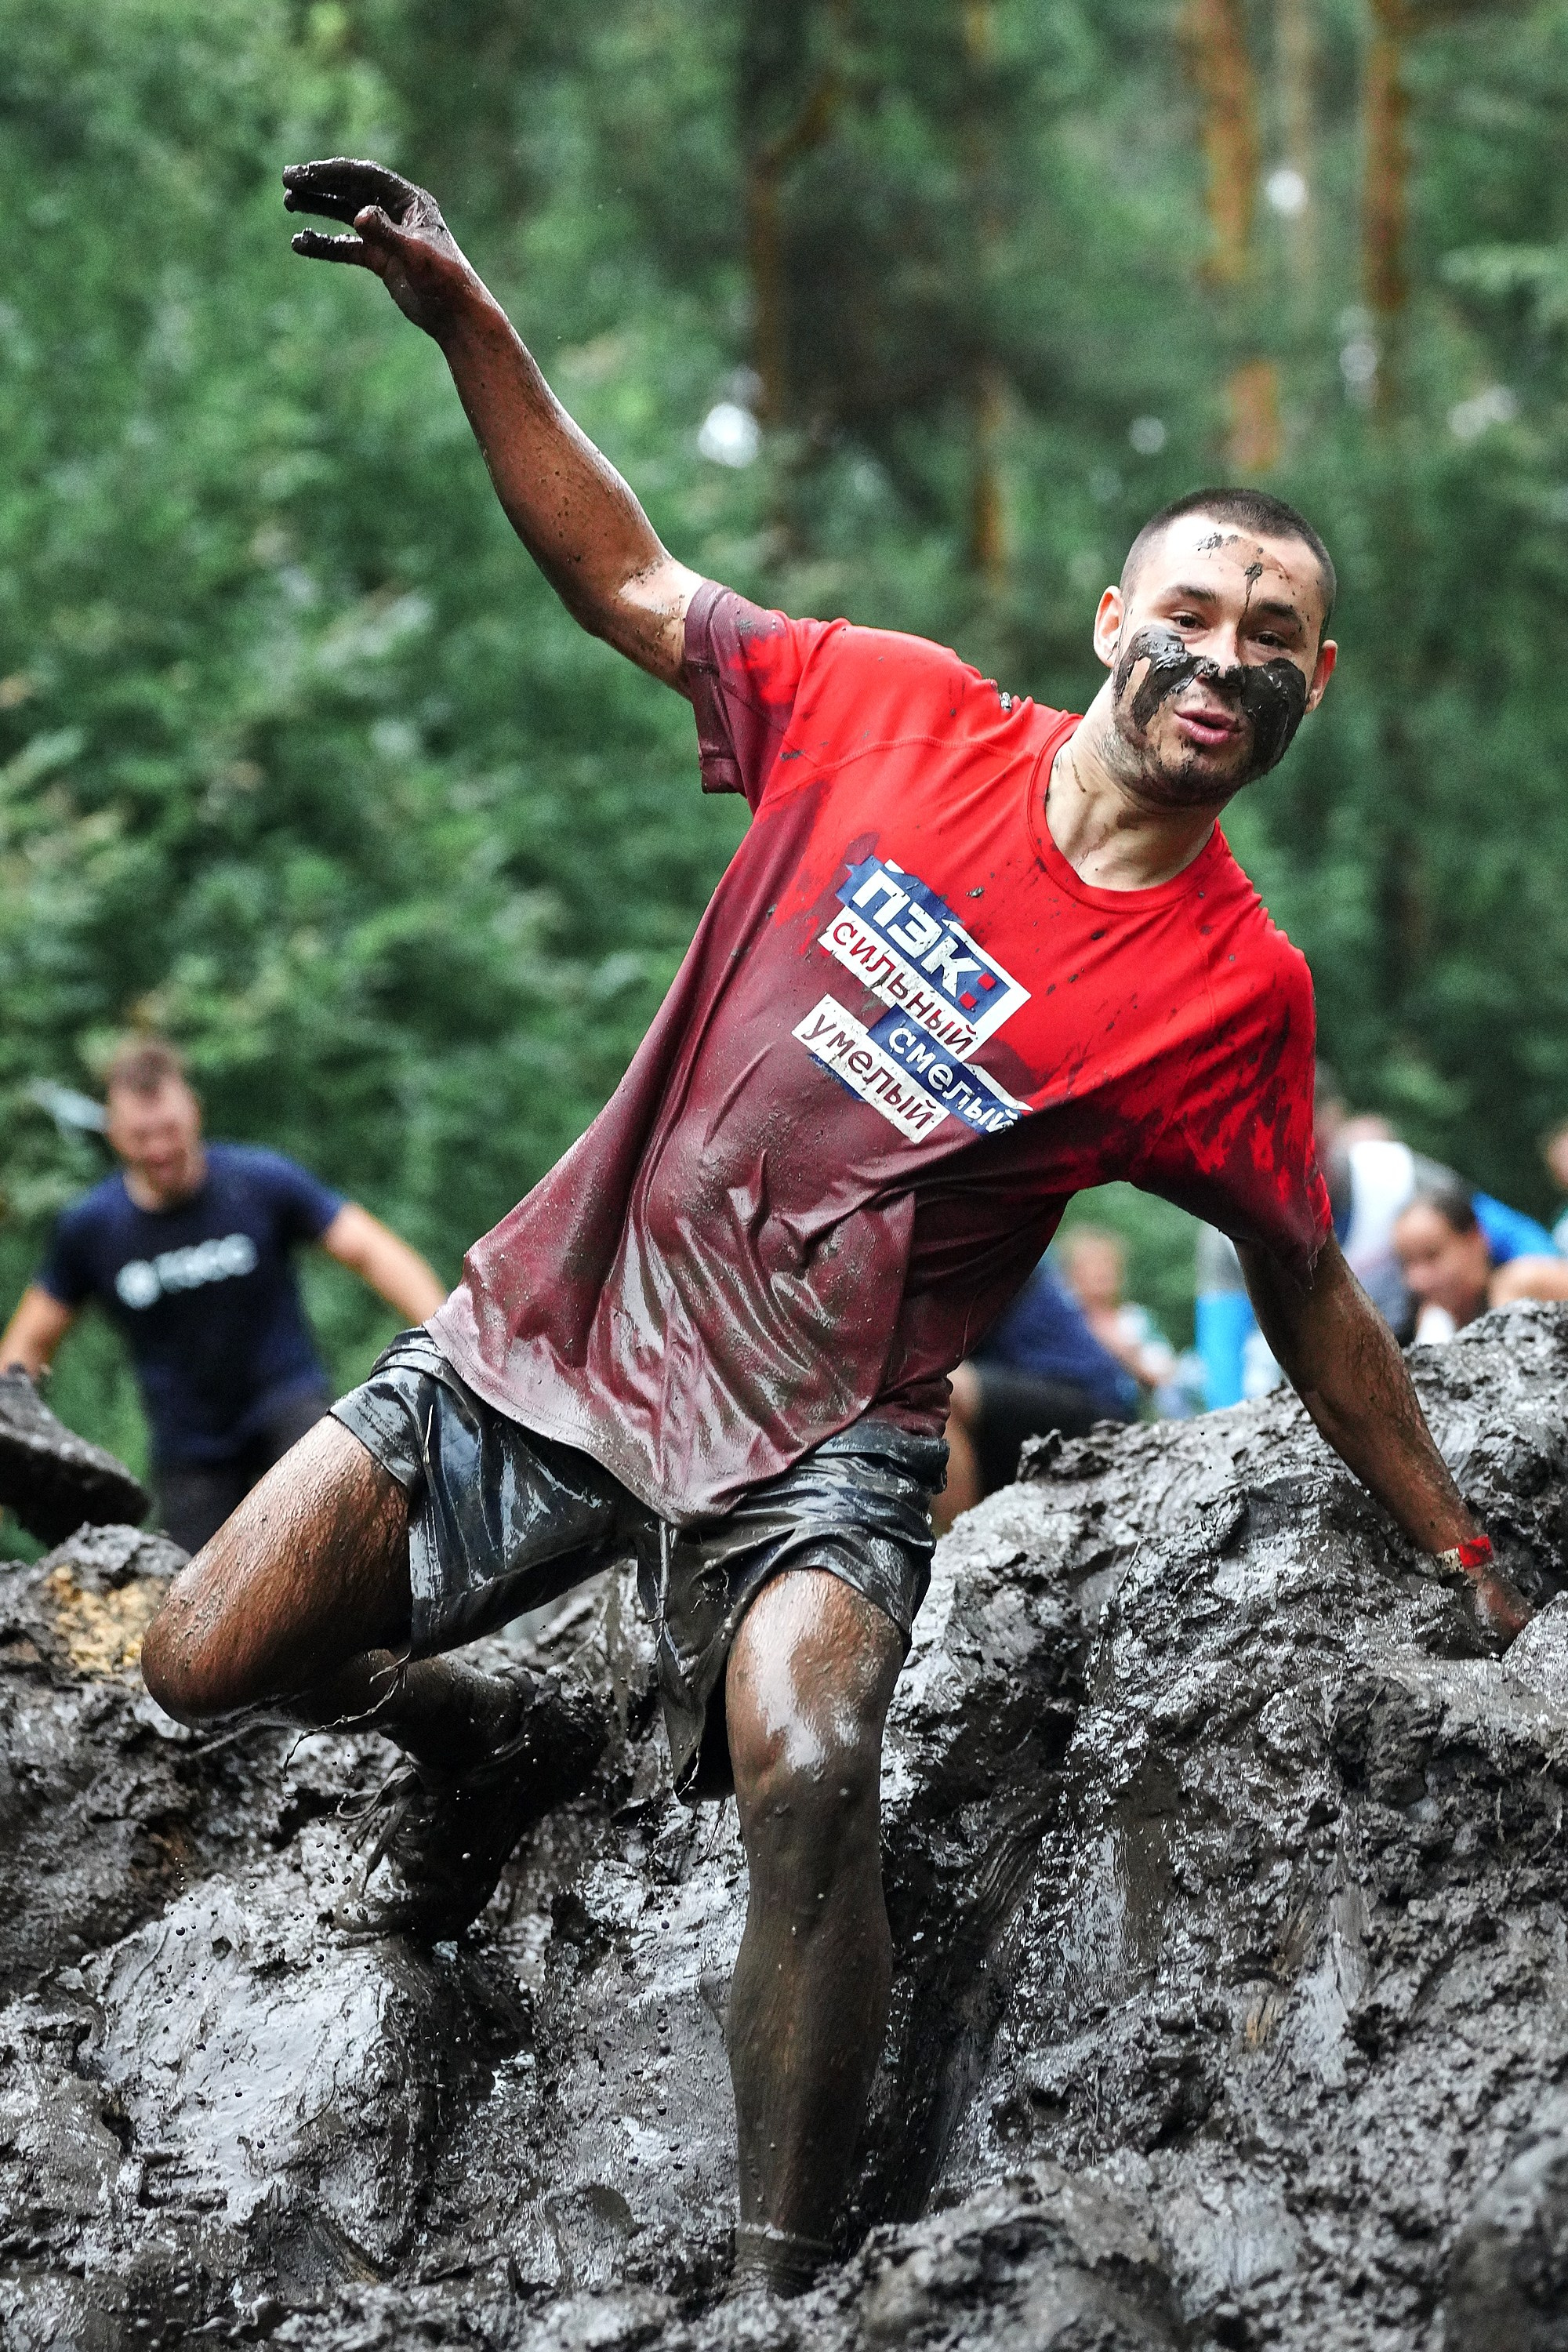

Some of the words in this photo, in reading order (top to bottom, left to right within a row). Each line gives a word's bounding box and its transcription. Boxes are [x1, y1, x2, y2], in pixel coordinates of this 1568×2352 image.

[833, 922, 977, 1054] сильный
[801, 1014, 936, 1130] умелый
[888, 1027, 1018, 1133] смелый
